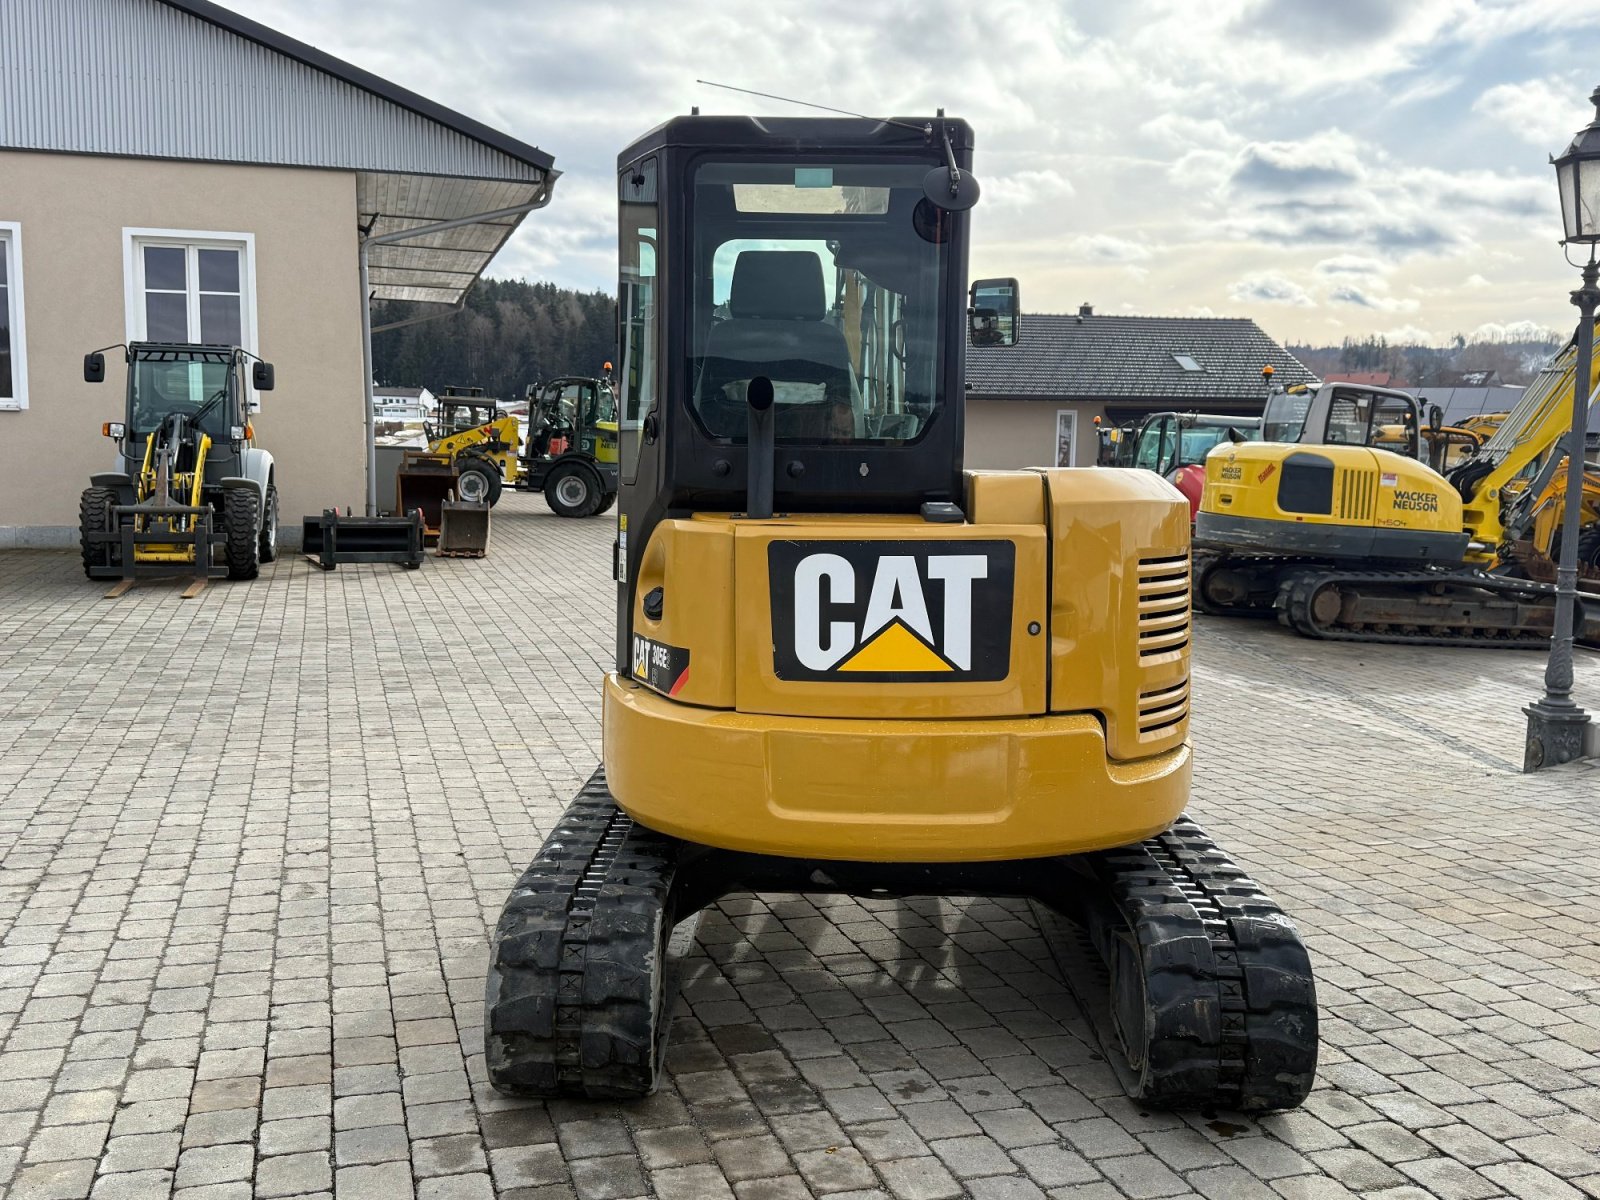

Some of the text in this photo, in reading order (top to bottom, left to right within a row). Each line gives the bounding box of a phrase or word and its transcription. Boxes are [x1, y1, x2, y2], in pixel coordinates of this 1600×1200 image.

[1392, 499, 1438, 512] NEUSON
[1393, 490, 1438, 502] WACKER
[794, 553, 988, 671] CAT
[634, 636, 651, 680] CAT
